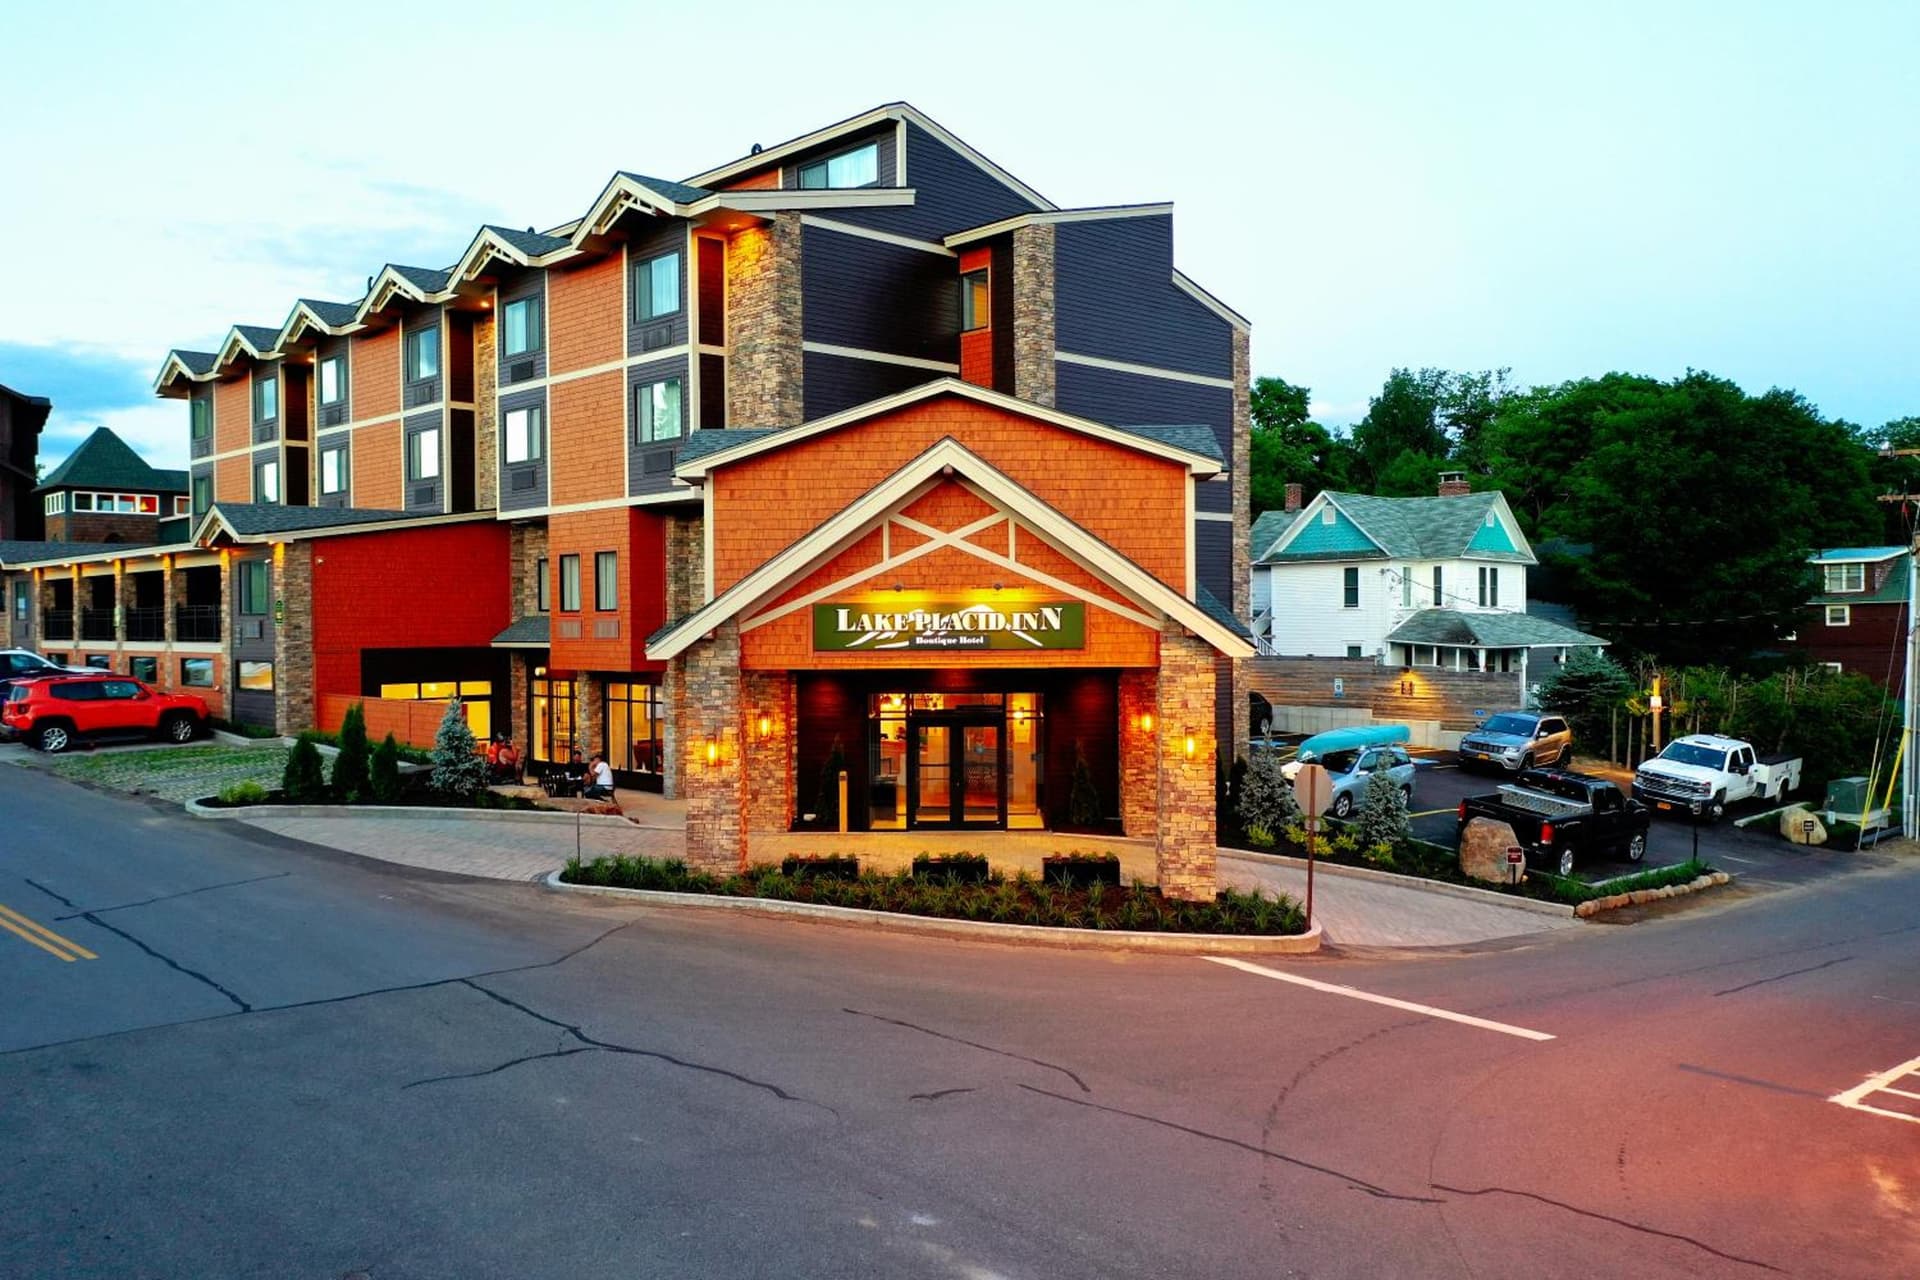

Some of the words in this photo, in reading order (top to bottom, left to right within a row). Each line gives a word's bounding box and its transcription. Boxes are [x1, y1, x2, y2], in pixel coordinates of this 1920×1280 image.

[836, 608, 909, 632] LAKE
[915, 611, 1006, 632] PLACID
[1011, 607, 1063, 632] INN
[916, 636, 958, 646] Boutique
[959, 636, 984, 645] Hotel
